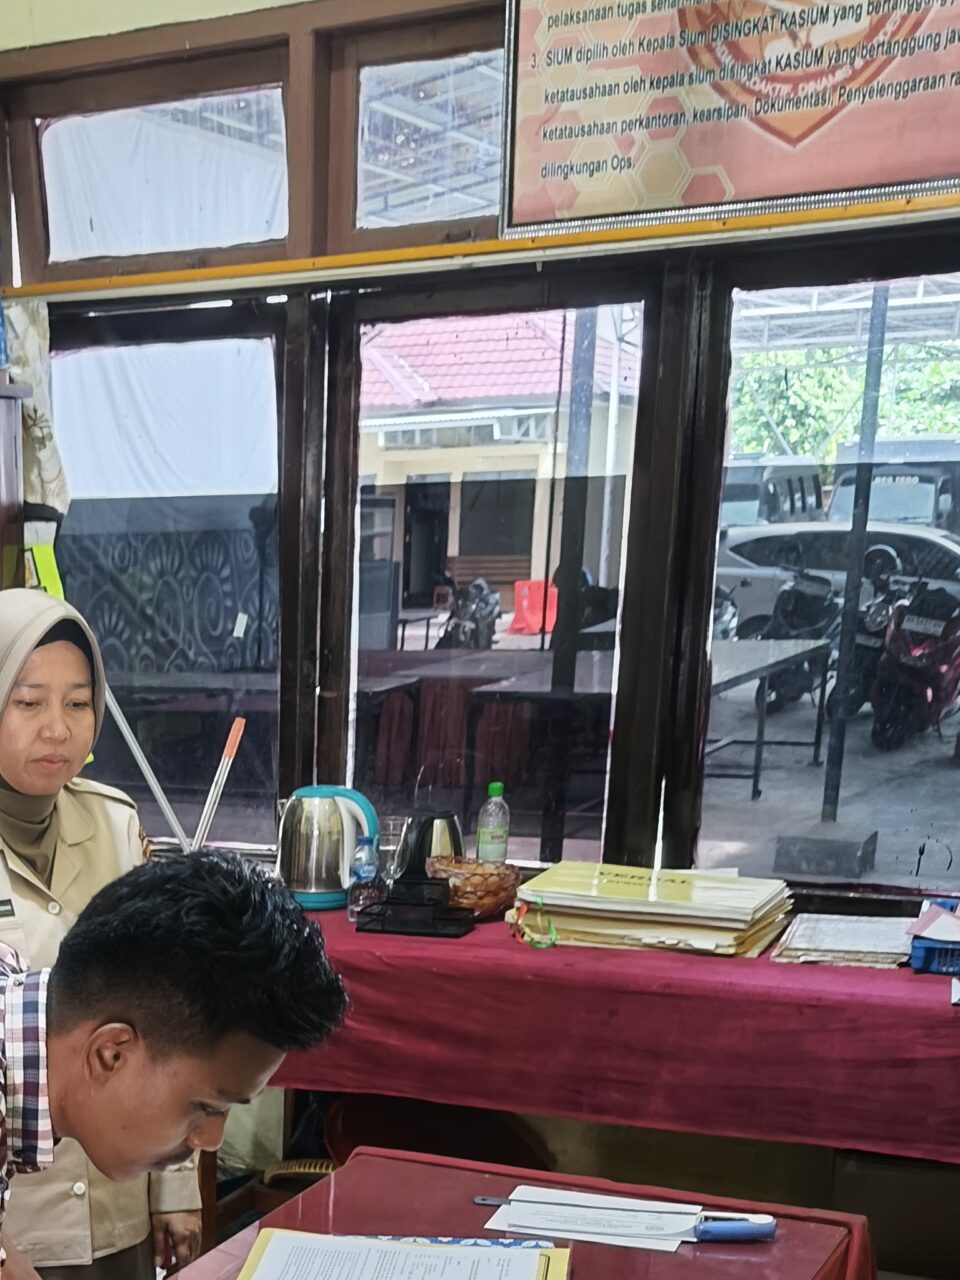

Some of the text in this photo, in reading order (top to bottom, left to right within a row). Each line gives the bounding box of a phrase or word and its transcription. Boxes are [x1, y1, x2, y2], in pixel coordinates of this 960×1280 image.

[546, 47, 573, 67] SIUM
[576, 42, 608, 65] dipilih
[612, 41, 634, 57] oleh
[639, 33, 675, 56] Kepala
[712, 15, 780, 42] DISINGKAT
[780, 8, 830, 32] KASIUM
[833, 2, 863, 26] yang
[547, 6, 614, 32] pelaksanaan
[617, 1, 647, 22] tugas
[544, 82, 619, 105] ketatausahaan
[623, 75, 645, 93] oleh
[649, 71, 685, 94] kepala
[719, 58, 772, 83] disingkat
[776, 47, 824, 71] KASIUM
[827, 46, 856, 69] yang
[861, 32, 941, 59] bertanggung
[943, 26, 960, 50] ja
[543, 118, 617, 141] ketatausahaan
[620, 111, 689, 135] perkantoran,
[754, 88, 833, 115] Dokumentasi,
[839, 72, 945, 105] Penyelenggaraan
[541, 154, 635, 181] dilingkungan Ops.
